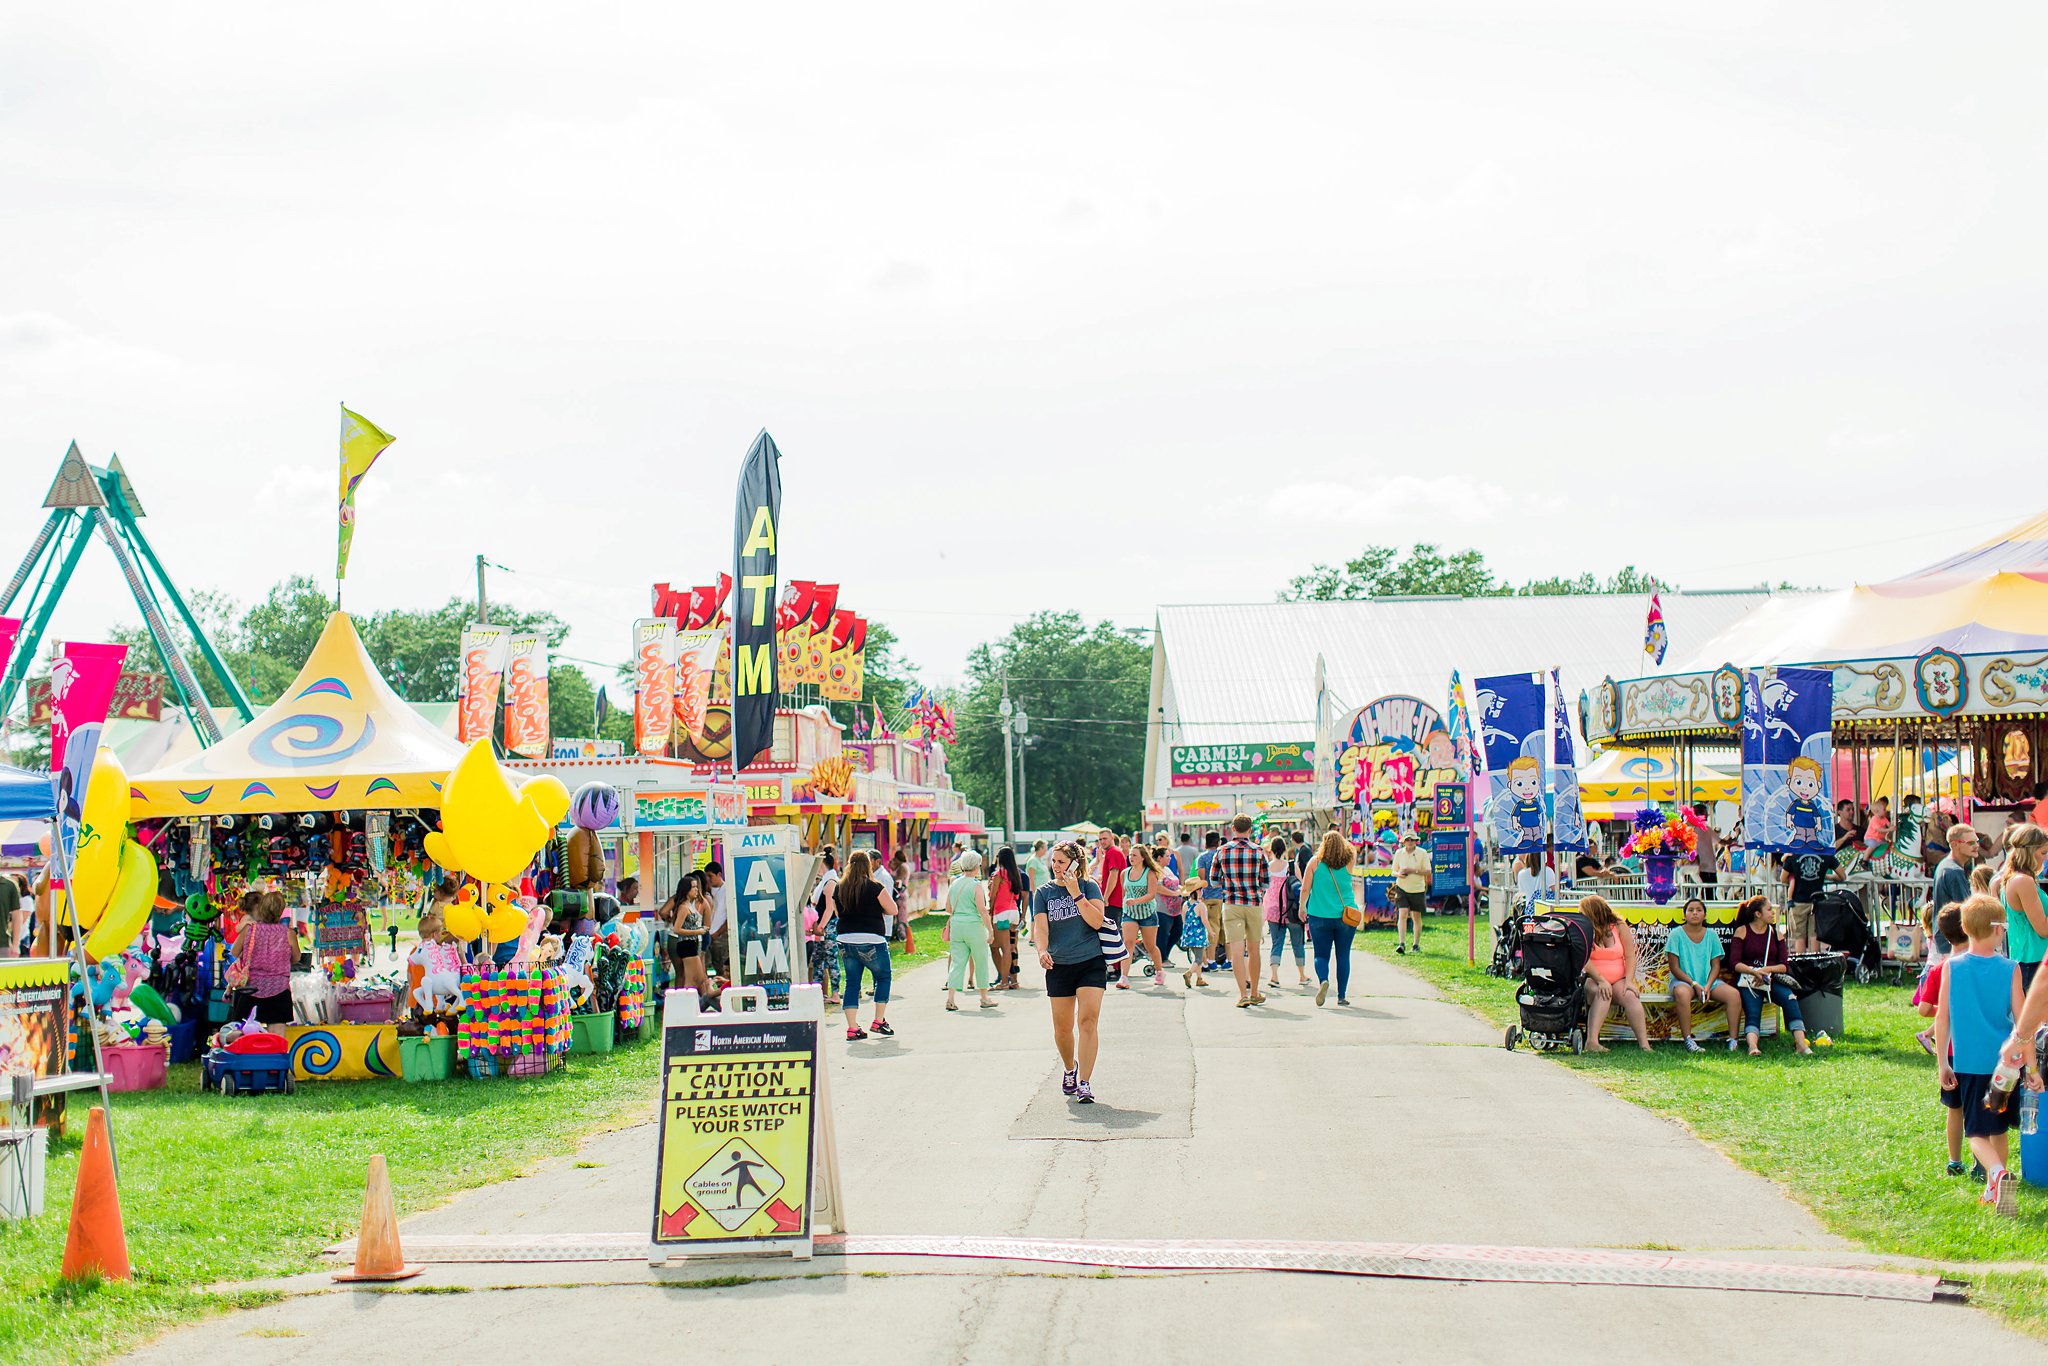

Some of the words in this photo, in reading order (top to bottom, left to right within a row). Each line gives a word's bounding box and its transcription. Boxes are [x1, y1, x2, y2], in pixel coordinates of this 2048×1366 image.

[737, 506, 776, 696] ATM
[469, 632, 500, 648] BUY
[640, 624, 666, 643] BUY
[511, 639, 537, 656] BUY
[681, 634, 711, 650] BUY
[466, 649, 493, 742] COUPONS
[639, 643, 670, 734] COUPONS
[511, 658, 548, 743] COUPONS
[1173, 745, 1250, 763] CARMEL
[1180, 761, 1242, 773] CORN
[745, 785, 780, 800] RIES
[637, 797, 704, 822] TICKETS
[1173, 807, 1203, 817] Kettle
[1204, 805, 1229, 816] Corn
[1441, 800, 1449, 814] 3
[742, 833, 776, 848] ATM
[743, 859, 790, 976] ATM
[757, 978, 788, 986] CAROLINA
[690, 1072, 784, 1090] CAUTION
[676, 1104, 739, 1119] PLEASE
[742, 1102, 802, 1117] WATCH
[692, 1120, 739, 1134] YOUR
[743, 1118, 785, 1132] STEP
[692, 1180, 720, 1188] Cables
[696, 1187, 728, 1197] ground
